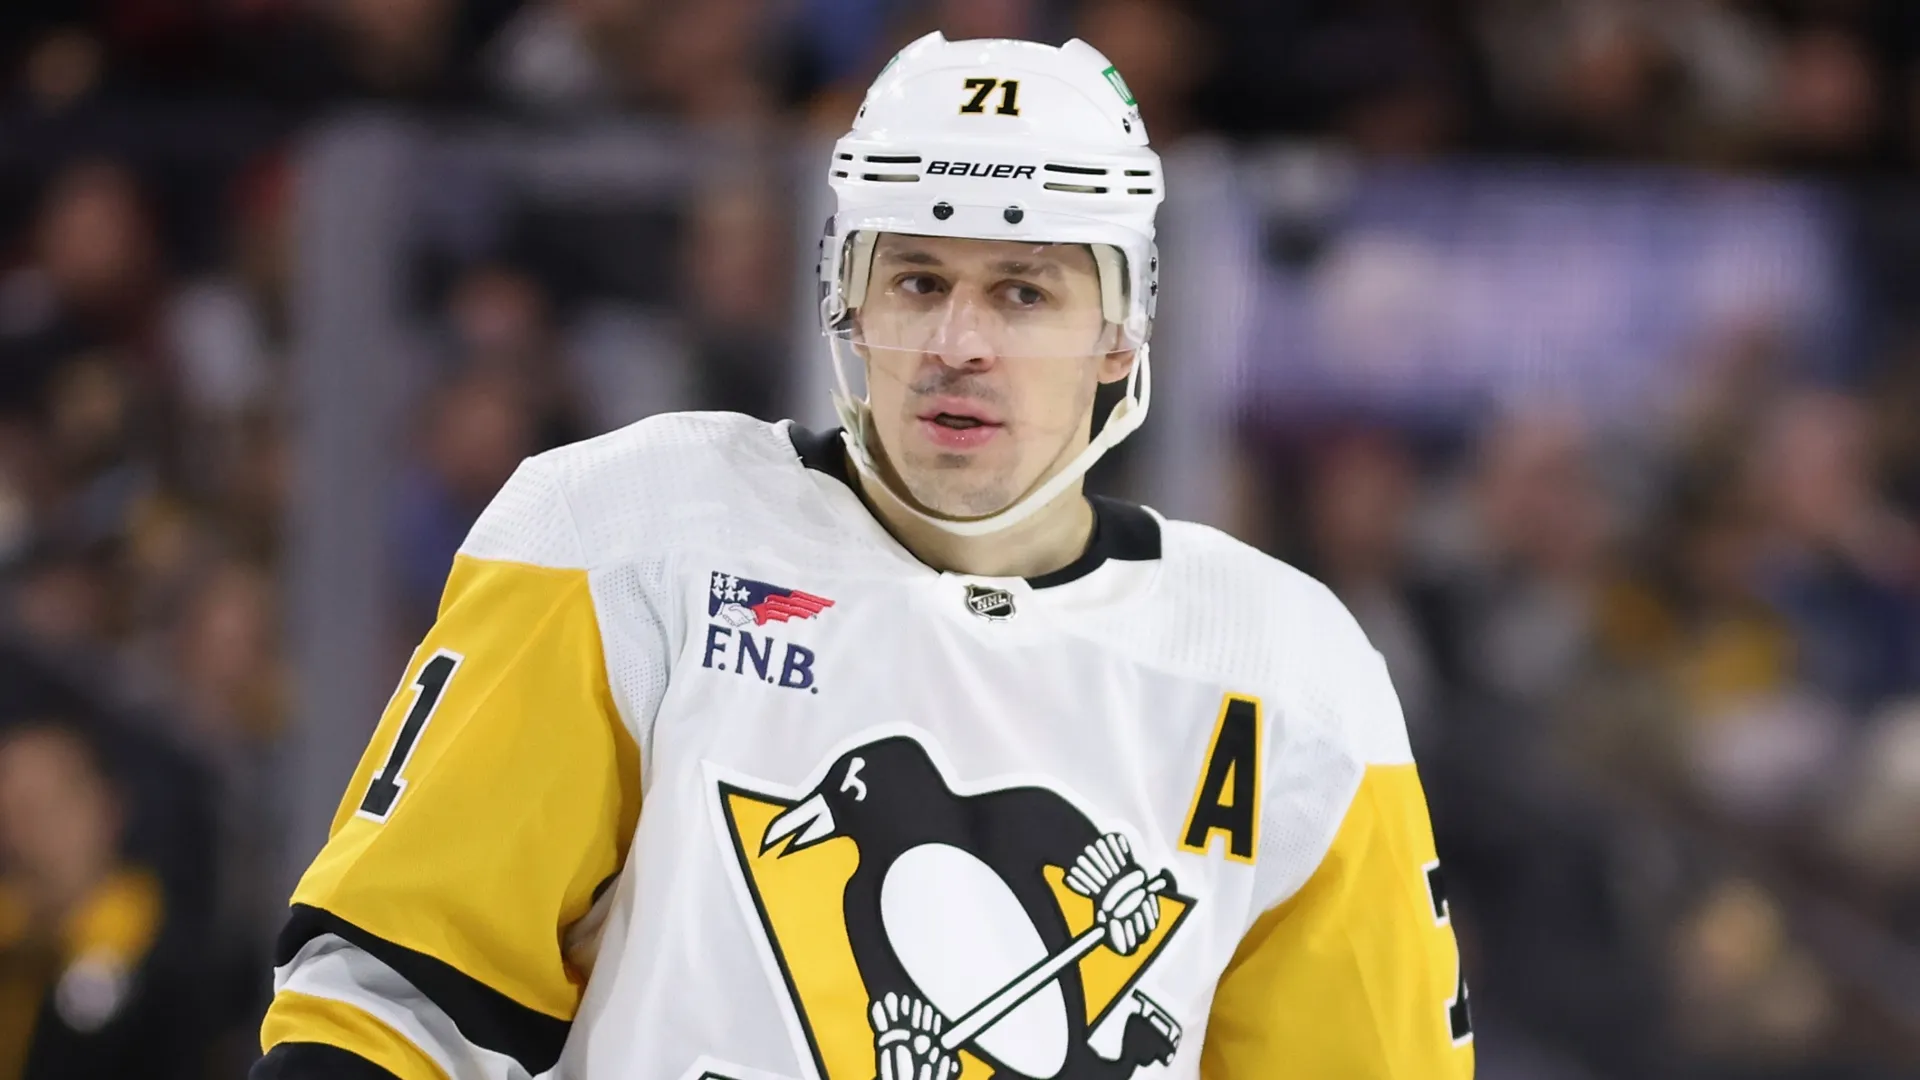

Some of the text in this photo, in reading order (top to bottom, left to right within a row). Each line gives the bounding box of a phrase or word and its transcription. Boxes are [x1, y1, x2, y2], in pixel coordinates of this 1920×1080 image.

[960, 78, 1019, 116] 71
[702, 623, 818, 694] F.N.B.
[1178, 692, 1262, 865] A
